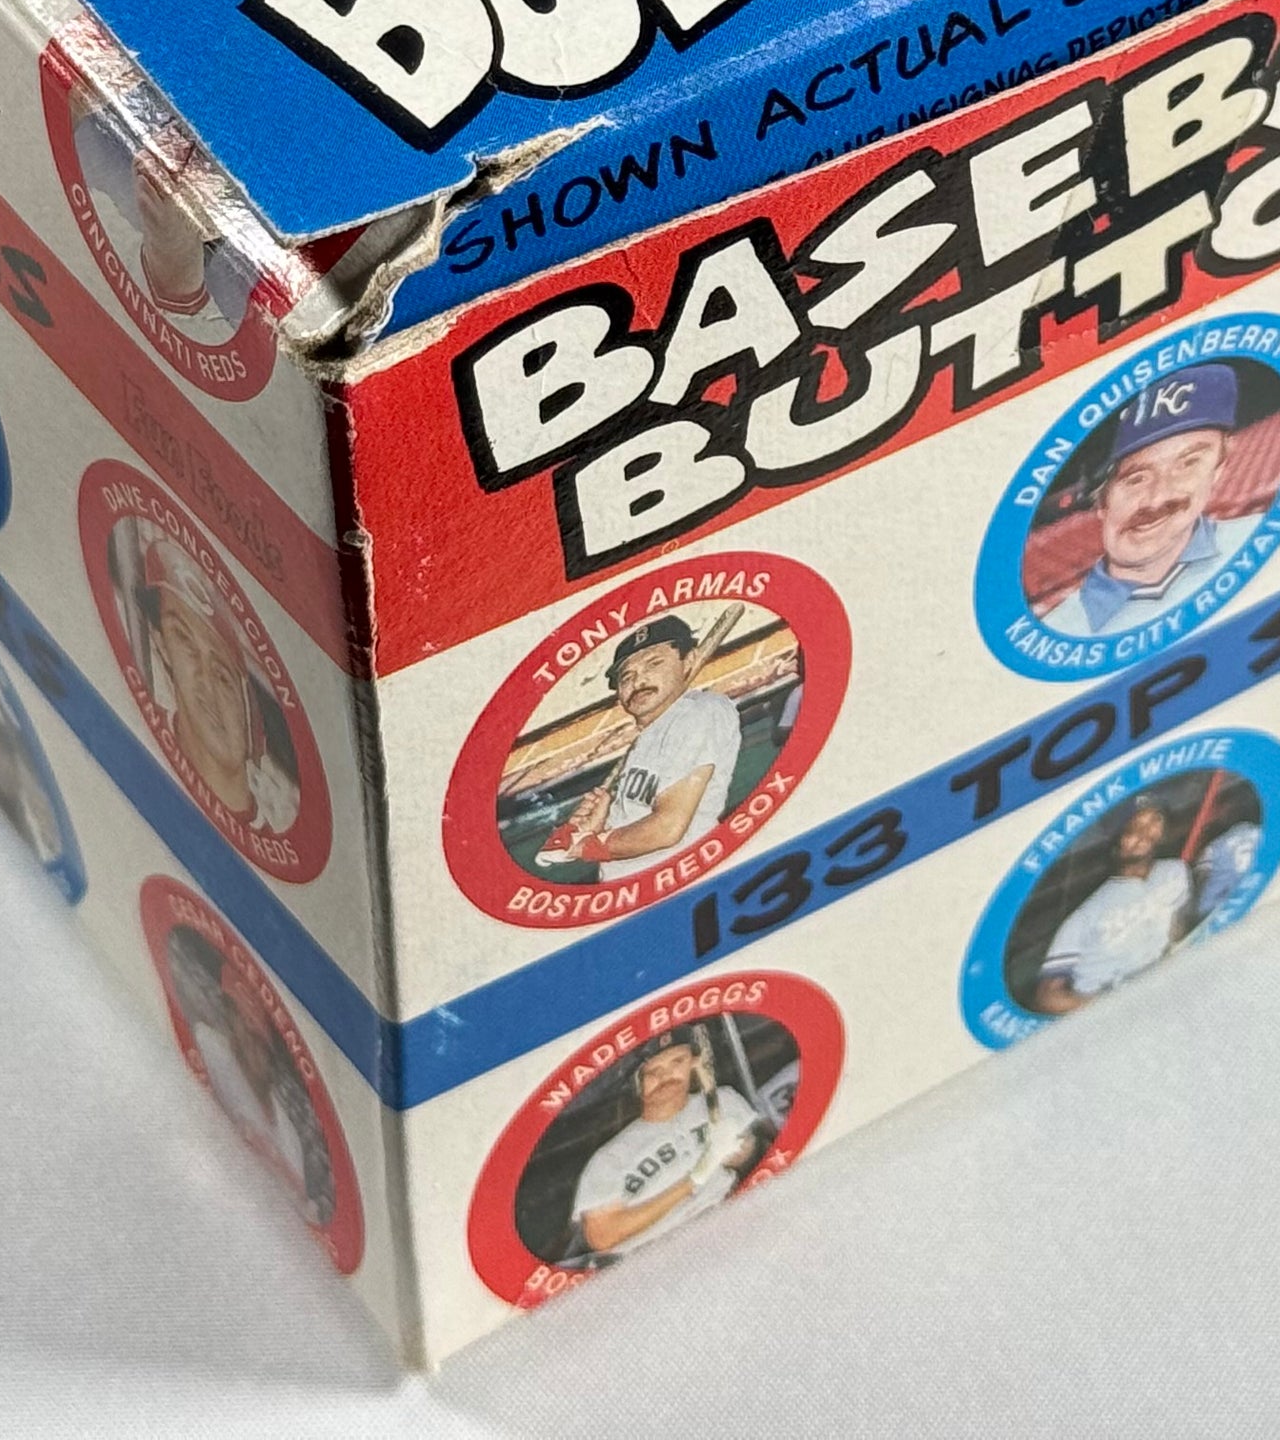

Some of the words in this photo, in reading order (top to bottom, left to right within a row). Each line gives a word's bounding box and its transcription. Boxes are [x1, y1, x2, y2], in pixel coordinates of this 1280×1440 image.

[445, 118, 718, 274] SHOWN
[71, 182, 193, 370] CINCINNATI
[197, 351, 248, 383] REDS
[1150, 381, 1198, 419] KC
[1014, 436, 1075, 508] DAN
[102, 485, 148, 515] DAVE
[152, 497, 297, 710] CONCEPCION
[532, 604, 632, 686] TONY
[646, 570, 771, 615] ARMAS
[1005, 615, 1104, 667] KANSAS
[1114, 613, 1183, 659] CITY
[125, 664, 246, 847] CINCINNATI
[250, 835, 300, 867] REDS
[691, 806, 909, 959] 133
[949, 653, 1209, 822] TOP
[1024, 782, 1128, 873] FRANK
[1138, 737, 1234, 780] WHITE
[506, 883, 641, 918] BOSTON
[655, 839, 725, 891] RED
[730, 769, 795, 834] SOX
[540, 1024, 639, 1111] WADE
[648, 980, 770, 1030] BOGGS
